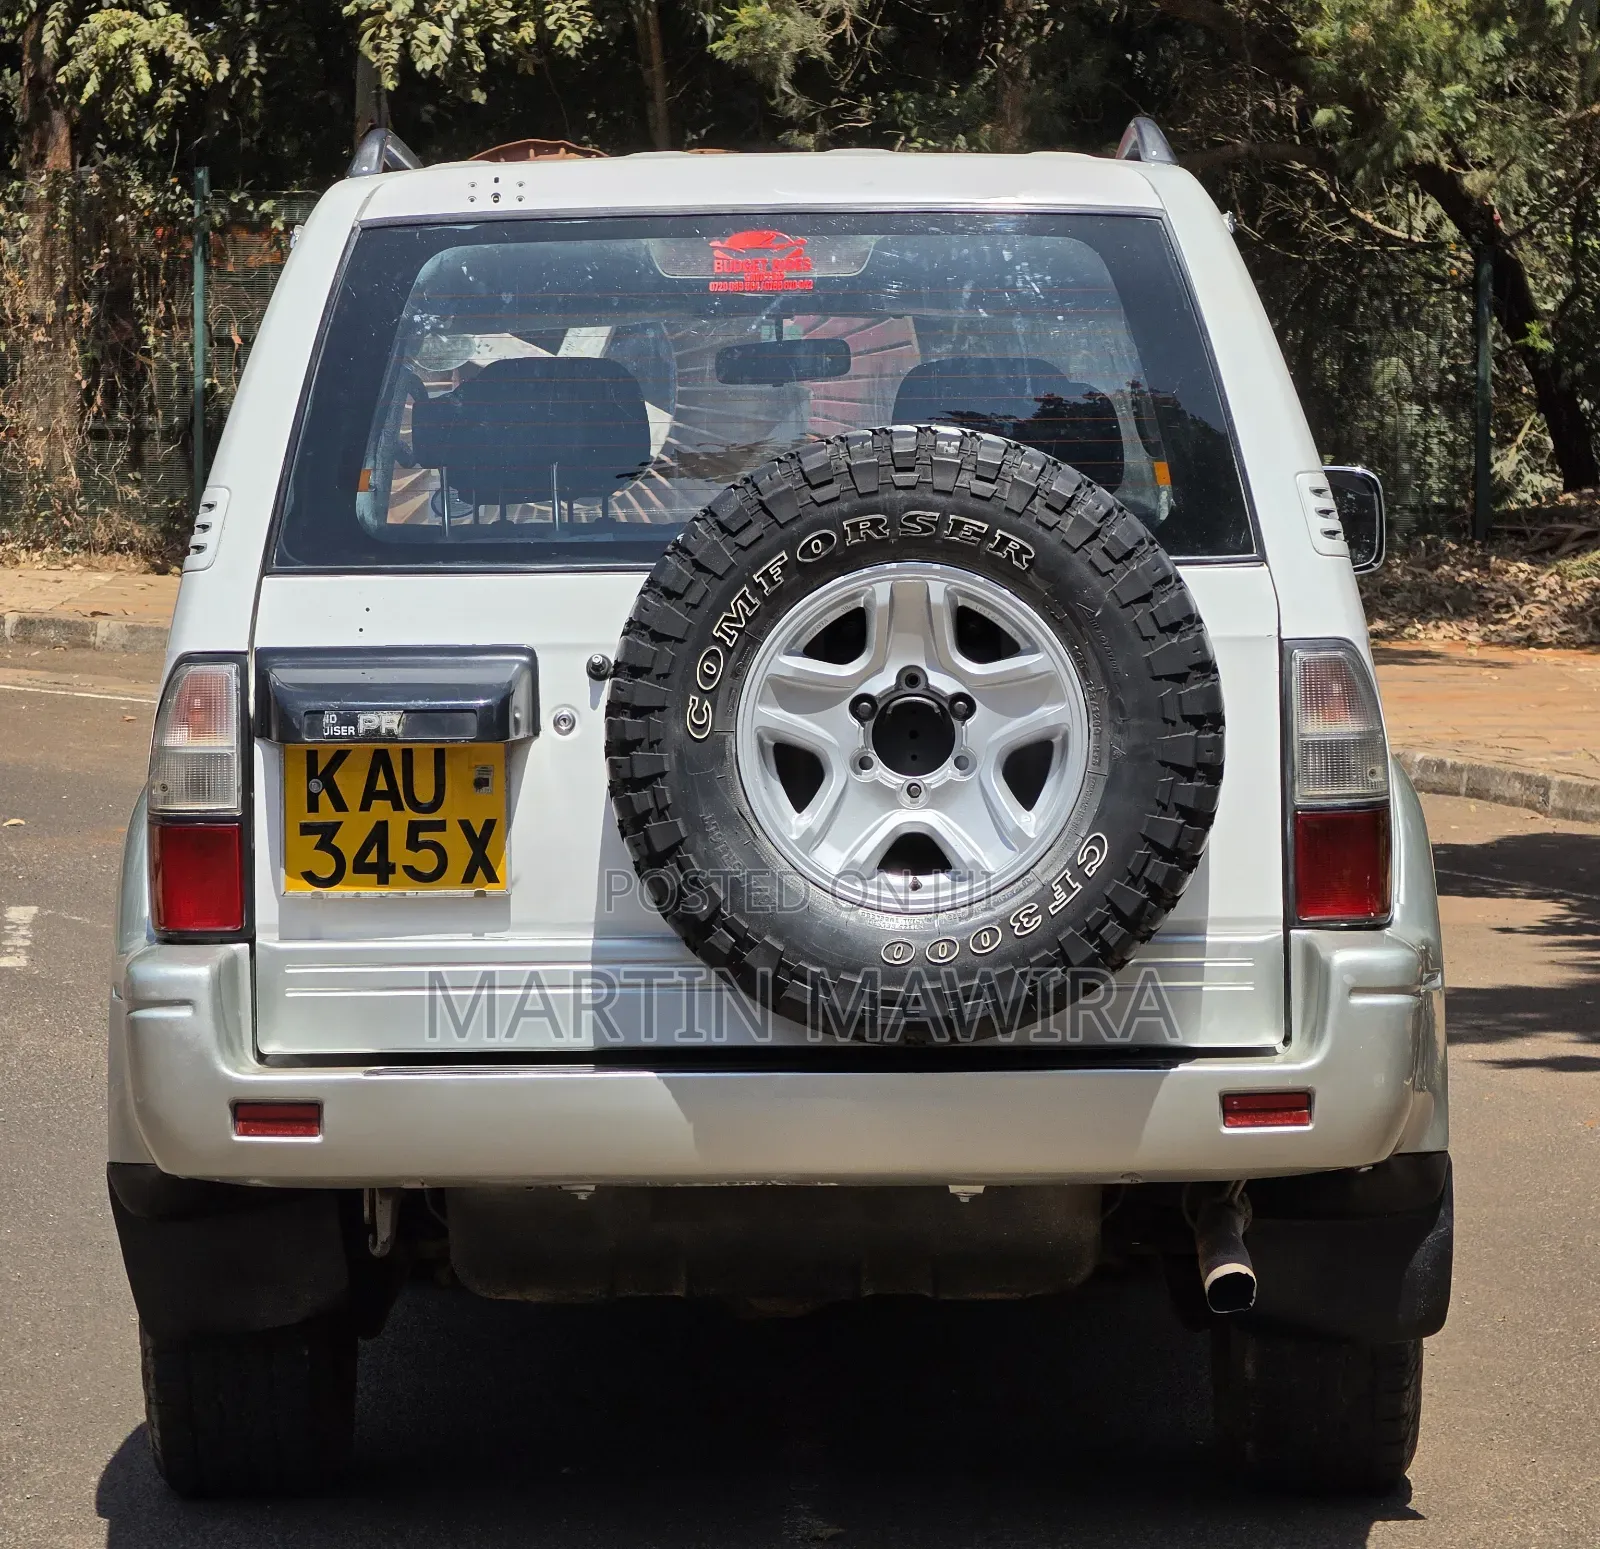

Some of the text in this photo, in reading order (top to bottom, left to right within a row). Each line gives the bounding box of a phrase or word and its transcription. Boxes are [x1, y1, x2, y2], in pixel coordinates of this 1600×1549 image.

[714, 258, 768, 273] BUDGET
[686, 510, 1036, 740] COMFORSER
[305, 748, 446, 814] KAU
[299, 819, 500, 889] 345X
